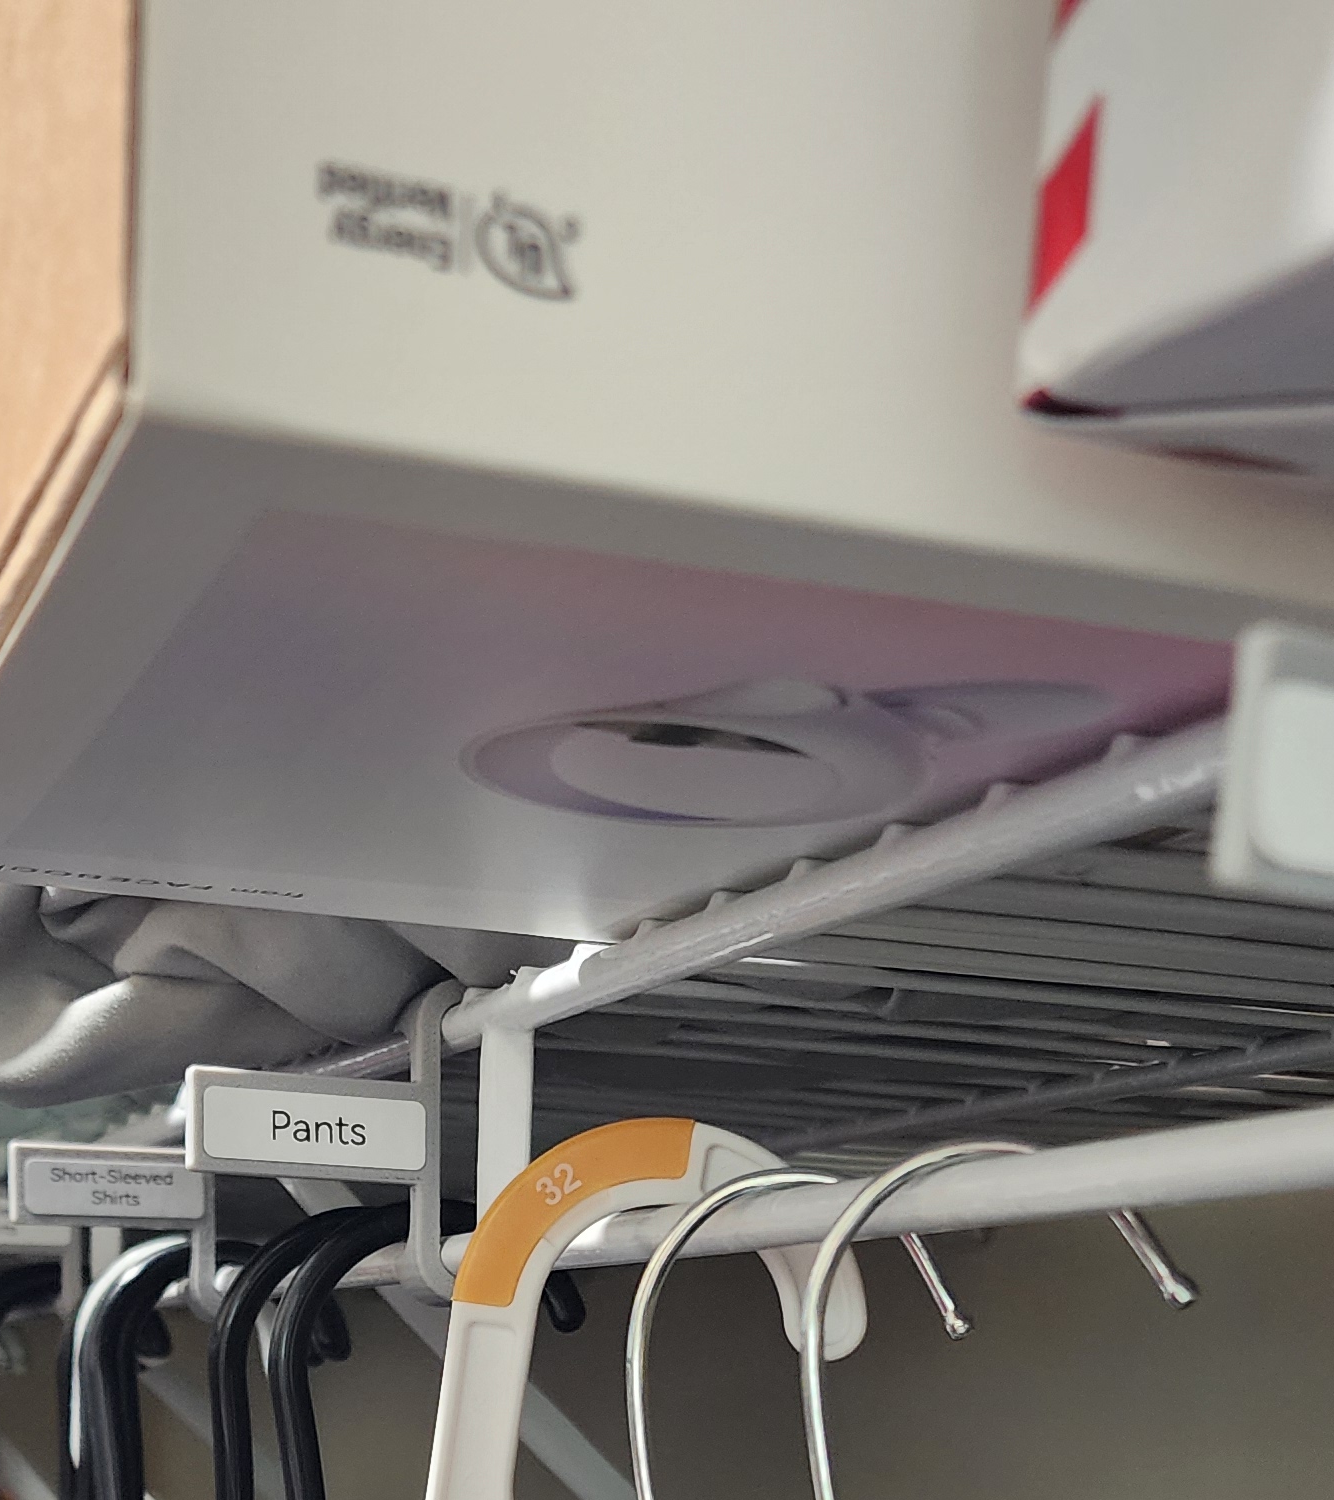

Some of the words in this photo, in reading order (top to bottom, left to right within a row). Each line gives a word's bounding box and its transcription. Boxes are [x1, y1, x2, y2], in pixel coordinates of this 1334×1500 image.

[270, 1109, 368, 1148] Pants
[49, 1167, 174, 1187] Short-Sleeved
[536, 1163, 582, 1205] 32
[91, 1190, 140, 1207] Shirts
